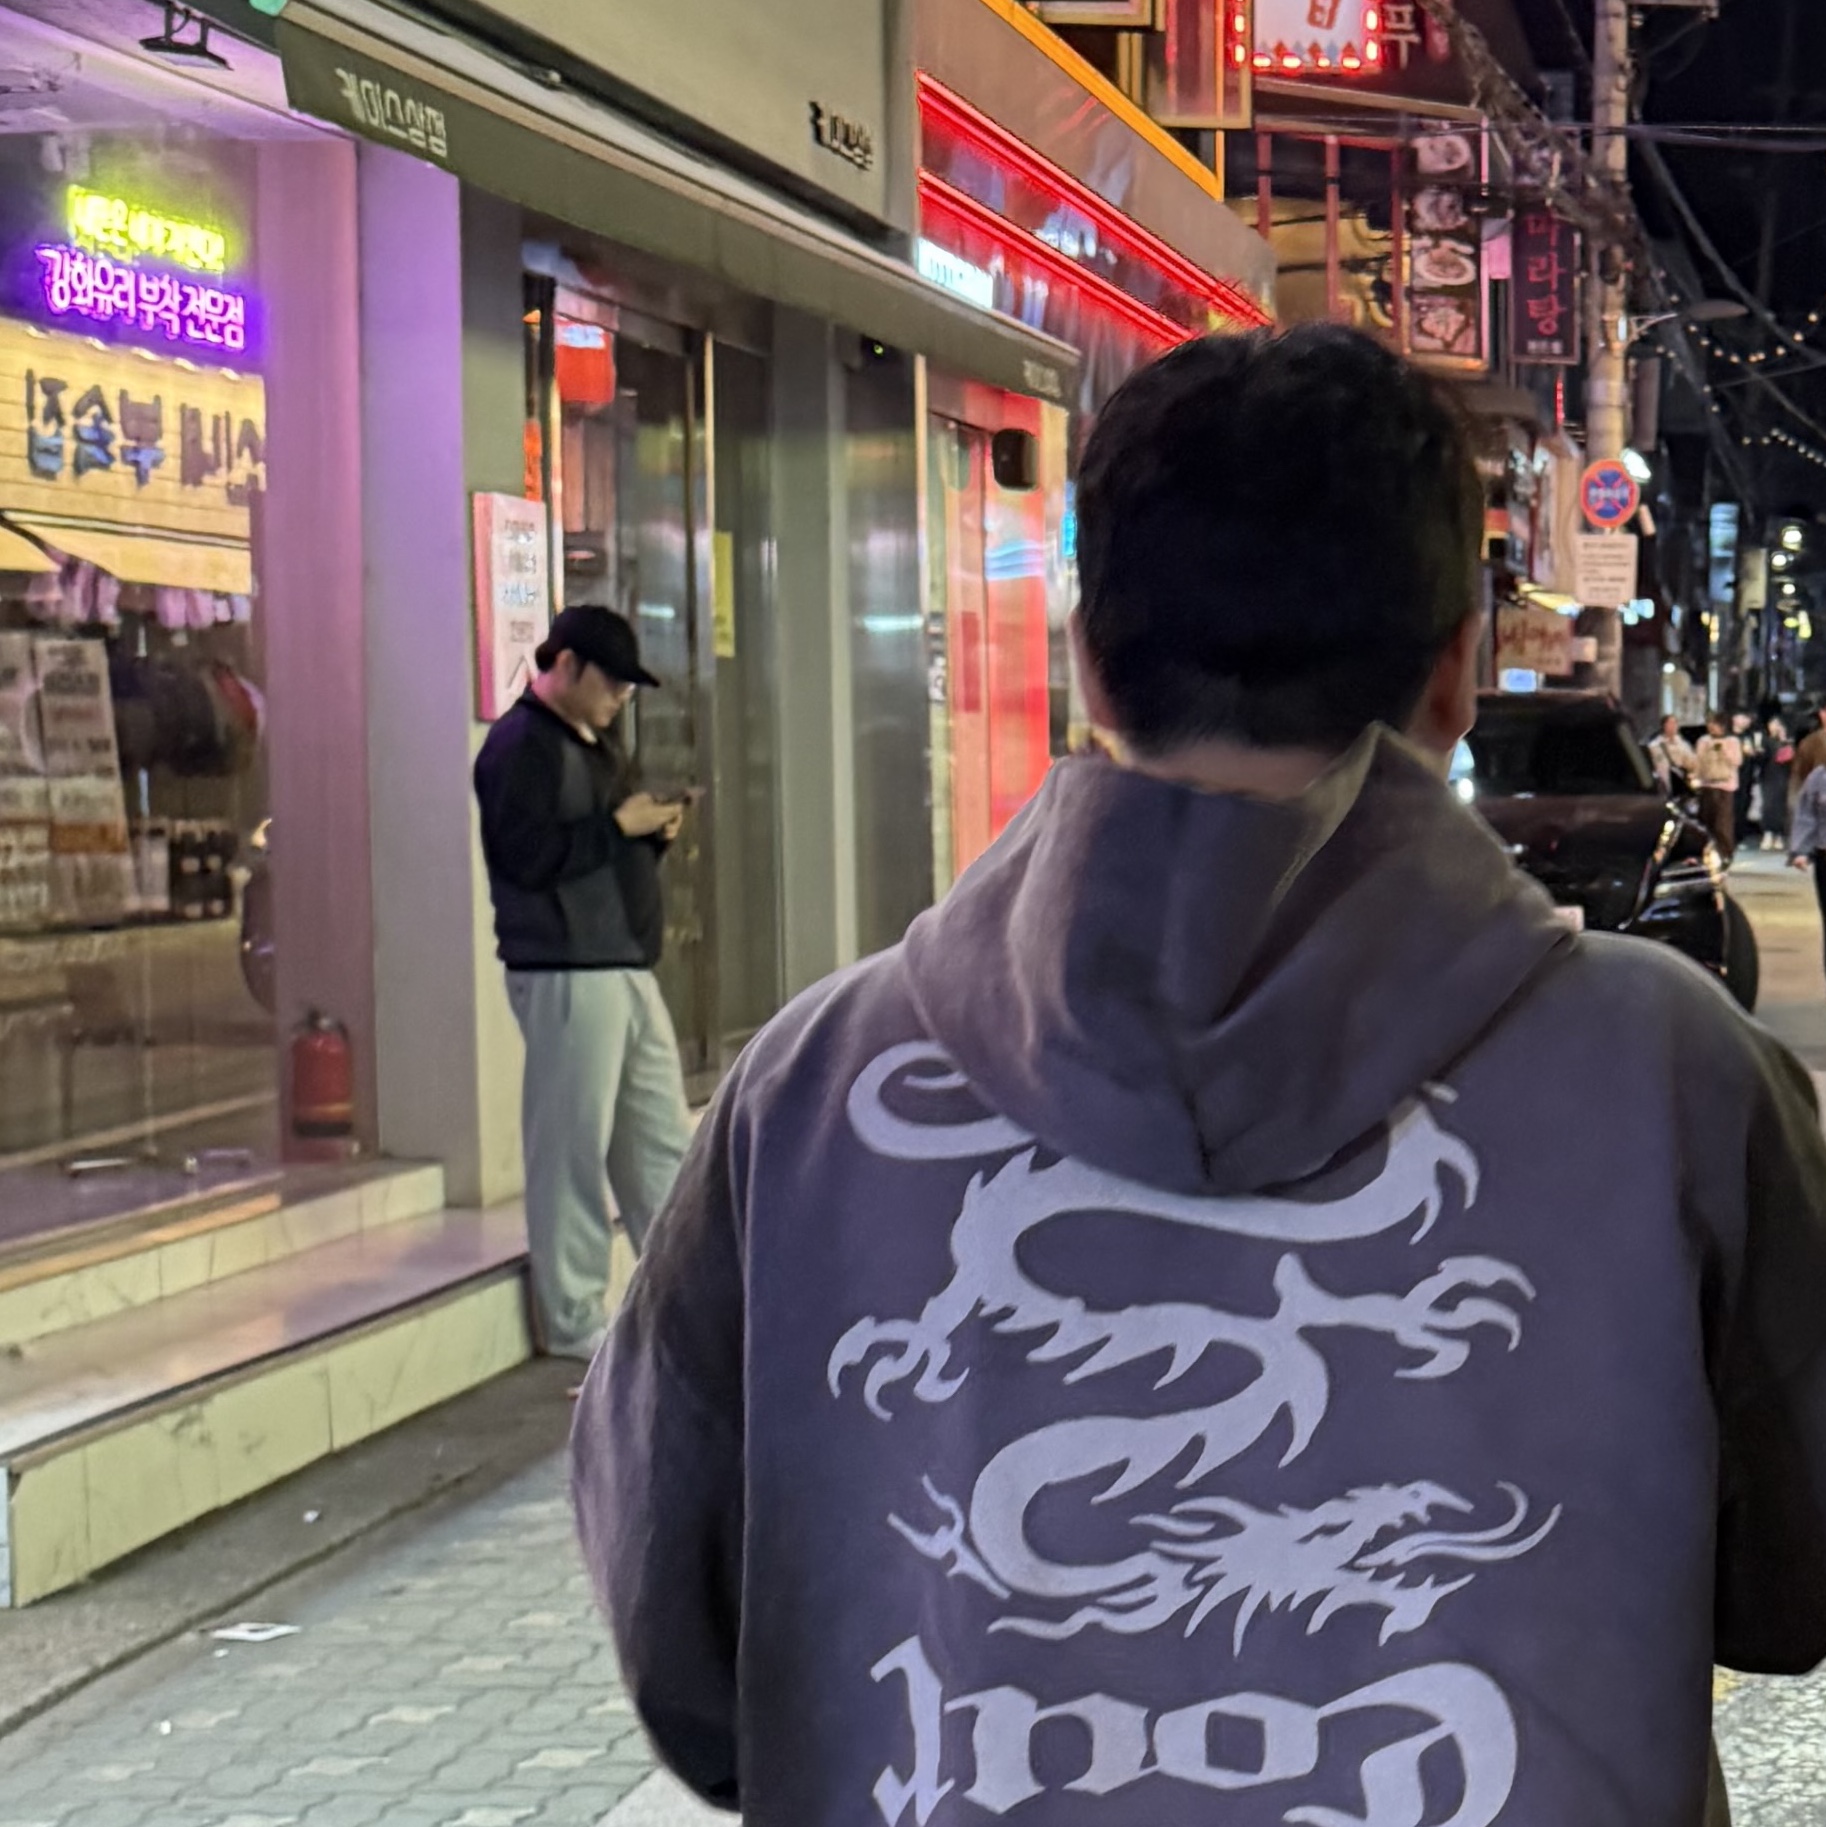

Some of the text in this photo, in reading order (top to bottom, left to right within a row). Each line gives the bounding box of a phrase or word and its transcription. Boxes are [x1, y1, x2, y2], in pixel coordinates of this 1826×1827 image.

[34, 246, 245, 350] 강화유리 부착 전문점
[1527, 208, 1566, 336] 마라탕
